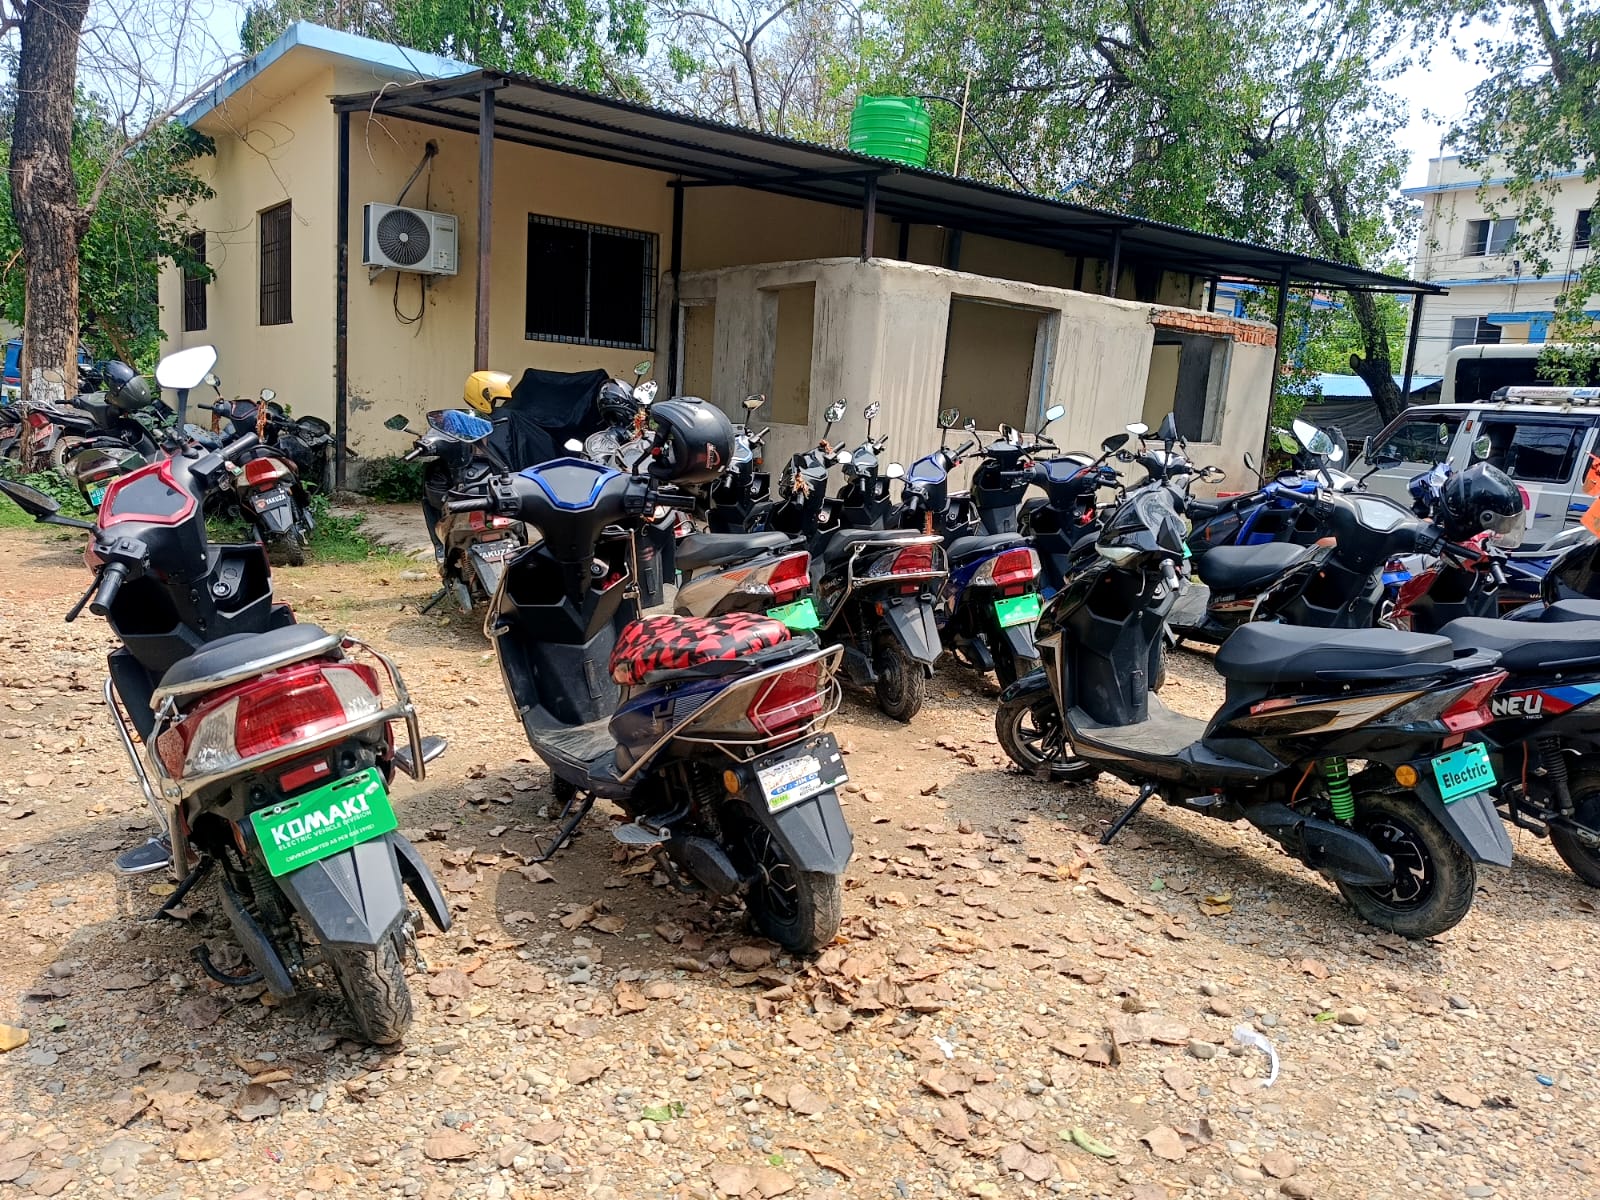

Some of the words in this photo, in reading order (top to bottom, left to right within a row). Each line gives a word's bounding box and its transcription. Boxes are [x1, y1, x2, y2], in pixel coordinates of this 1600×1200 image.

[1491, 694, 1544, 716] NEU
[1442, 763, 1488, 788] Electric
[271, 794, 370, 845] KOMAKI
[278, 834, 312, 851] ELECTRIC
[313, 822, 341, 837] VEHICLE
[342, 809, 372, 825] DIVISION
